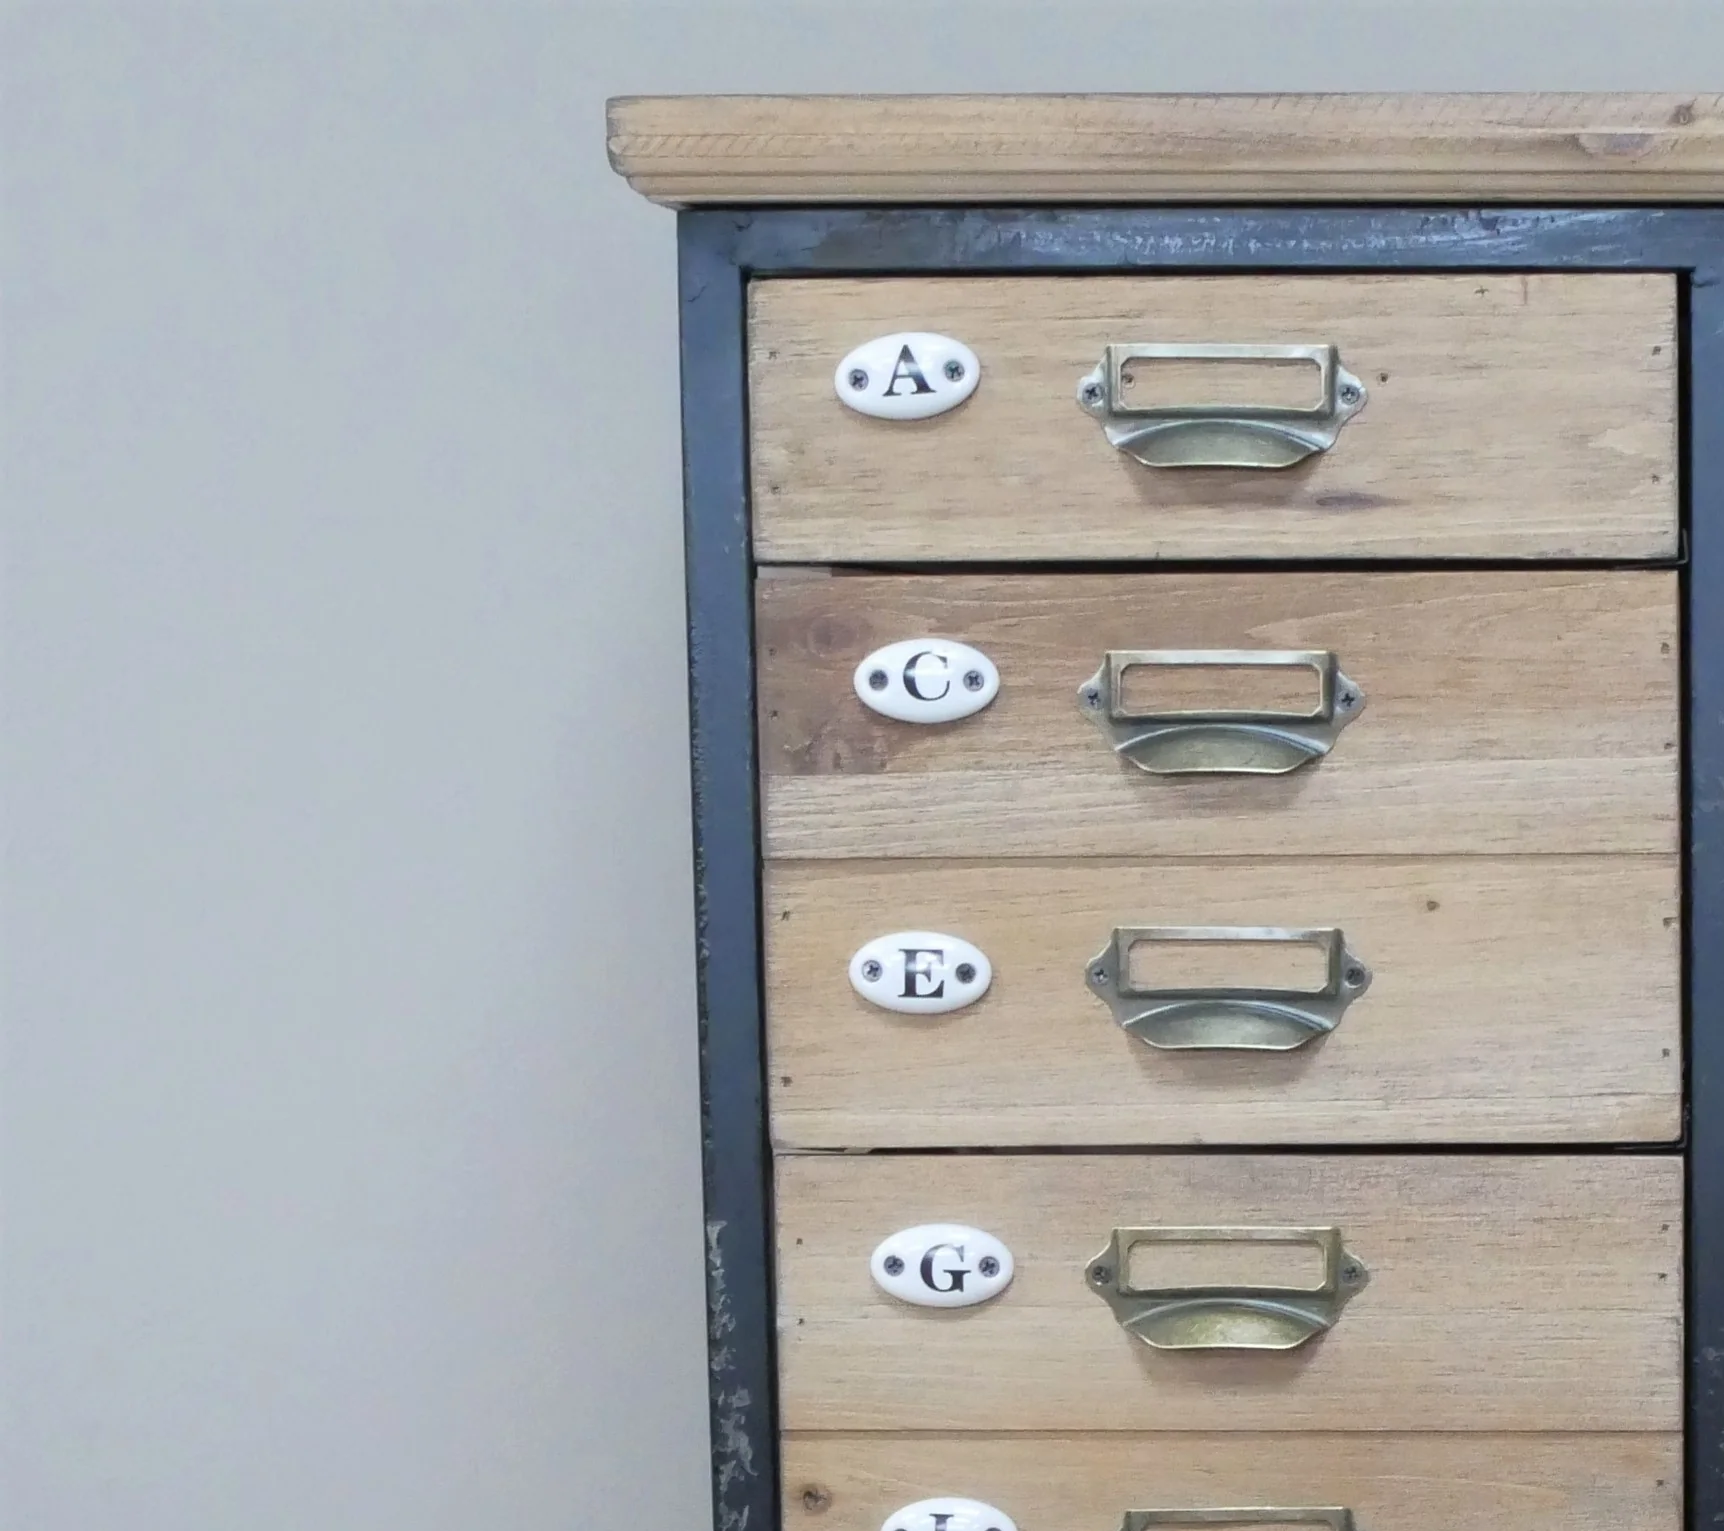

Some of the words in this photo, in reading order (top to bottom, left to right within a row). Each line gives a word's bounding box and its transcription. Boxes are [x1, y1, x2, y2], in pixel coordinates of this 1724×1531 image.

[882, 345, 937, 397] A
[903, 653, 949, 700] C
[898, 949, 945, 999] E
[921, 1243, 970, 1293] G
